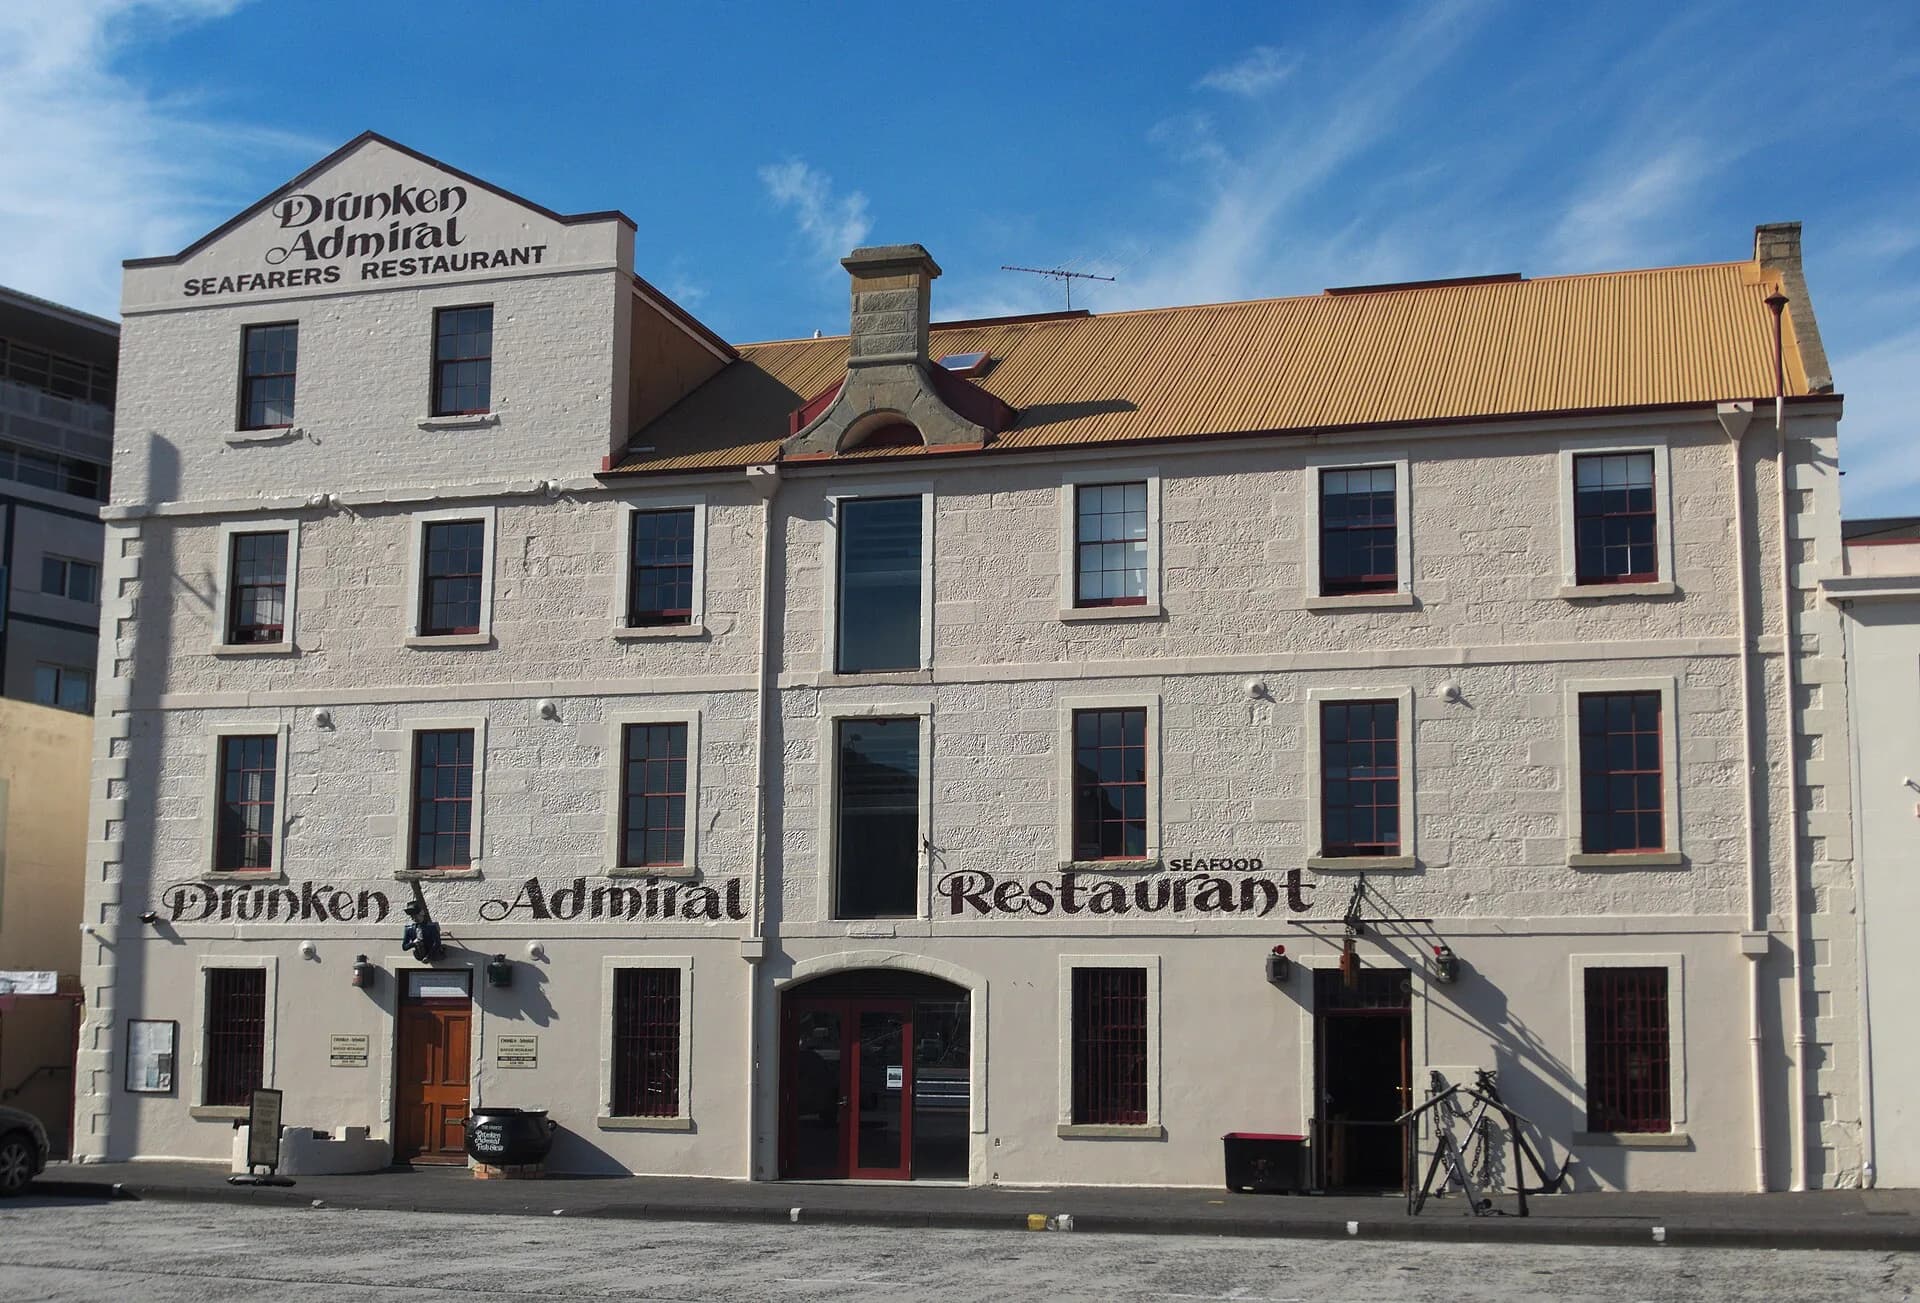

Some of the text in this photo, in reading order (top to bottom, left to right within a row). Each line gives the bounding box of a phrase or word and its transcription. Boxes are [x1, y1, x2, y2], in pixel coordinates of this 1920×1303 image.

[272, 184, 467, 228] Drunken
[265, 216, 467, 265] Admiral
[184, 245, 547, 296] SEAFARERS RESTAURANT
[1169, 858, 1263, 872] SEAFOOD
[162, 868, 1317, 924] Drunken Admiral Restaurant
